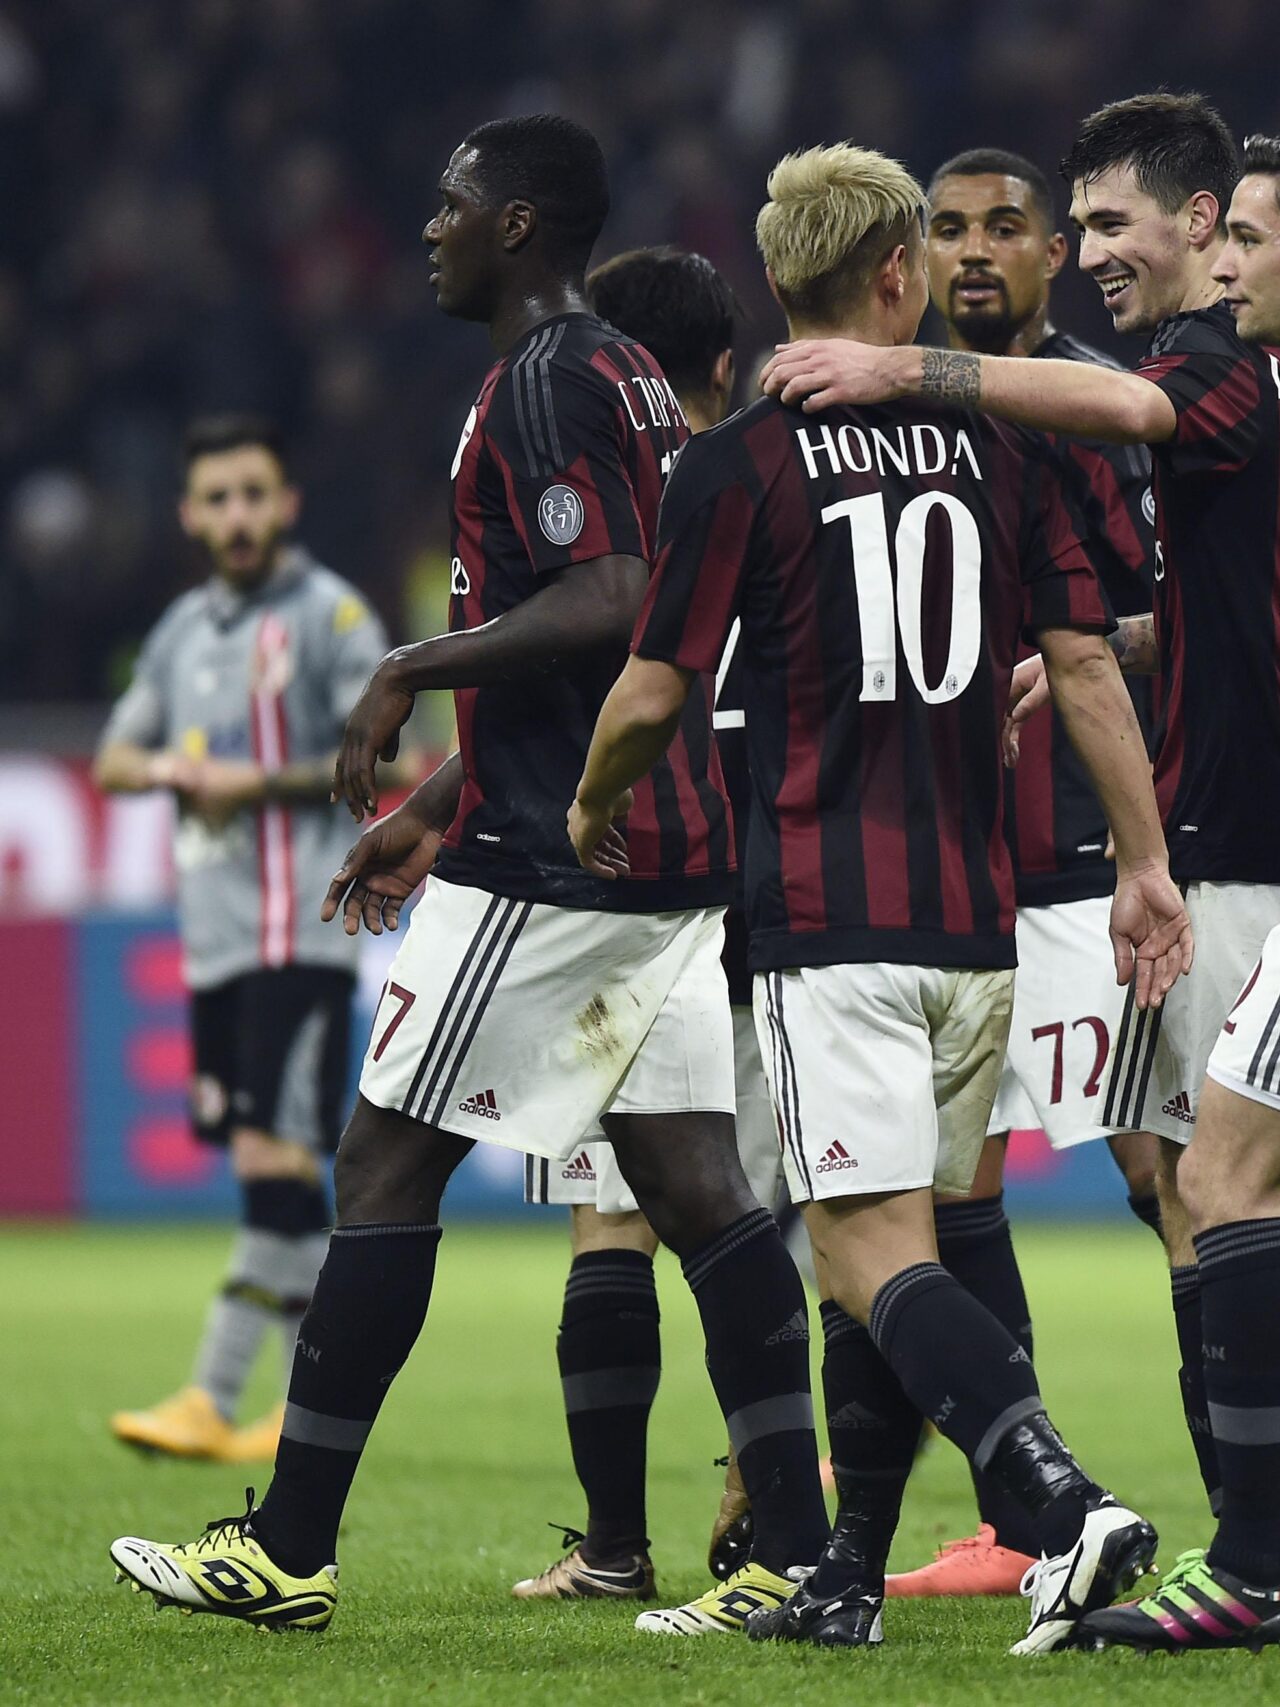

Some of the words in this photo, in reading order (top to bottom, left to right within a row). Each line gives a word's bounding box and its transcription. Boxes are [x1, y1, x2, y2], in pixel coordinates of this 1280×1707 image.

[618, 381, 646, 431] C
[795, 424, 983, 480] HONDA
[557, 513, 567, 529] 7
[821, 490, 982, 705] 10
[1031, 1016, 1110, 1106] 72
[458, 1100, 501, 1121] adidas
[1162, 1102, 1197, 1124] adidas
[815, 1158, 858, 1174] adidas
